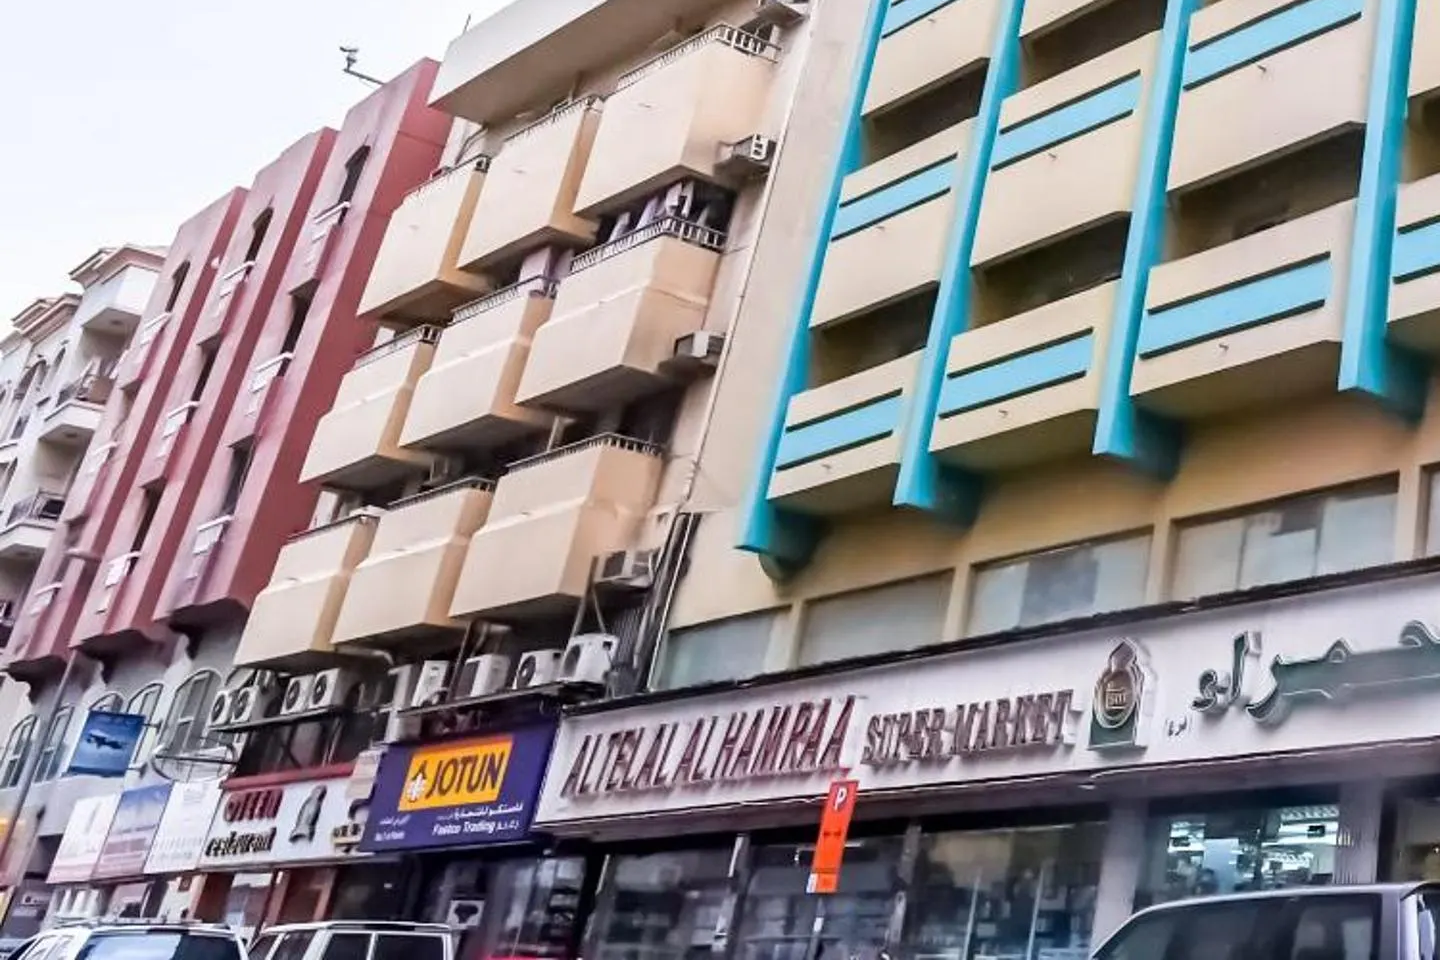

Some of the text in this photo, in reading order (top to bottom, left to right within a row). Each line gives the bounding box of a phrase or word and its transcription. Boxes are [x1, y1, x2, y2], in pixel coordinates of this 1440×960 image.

[425, 751, 505, 800] JOTUN
[834, 787, 848, 811] P
[463, 820, 496, 834] Trading
